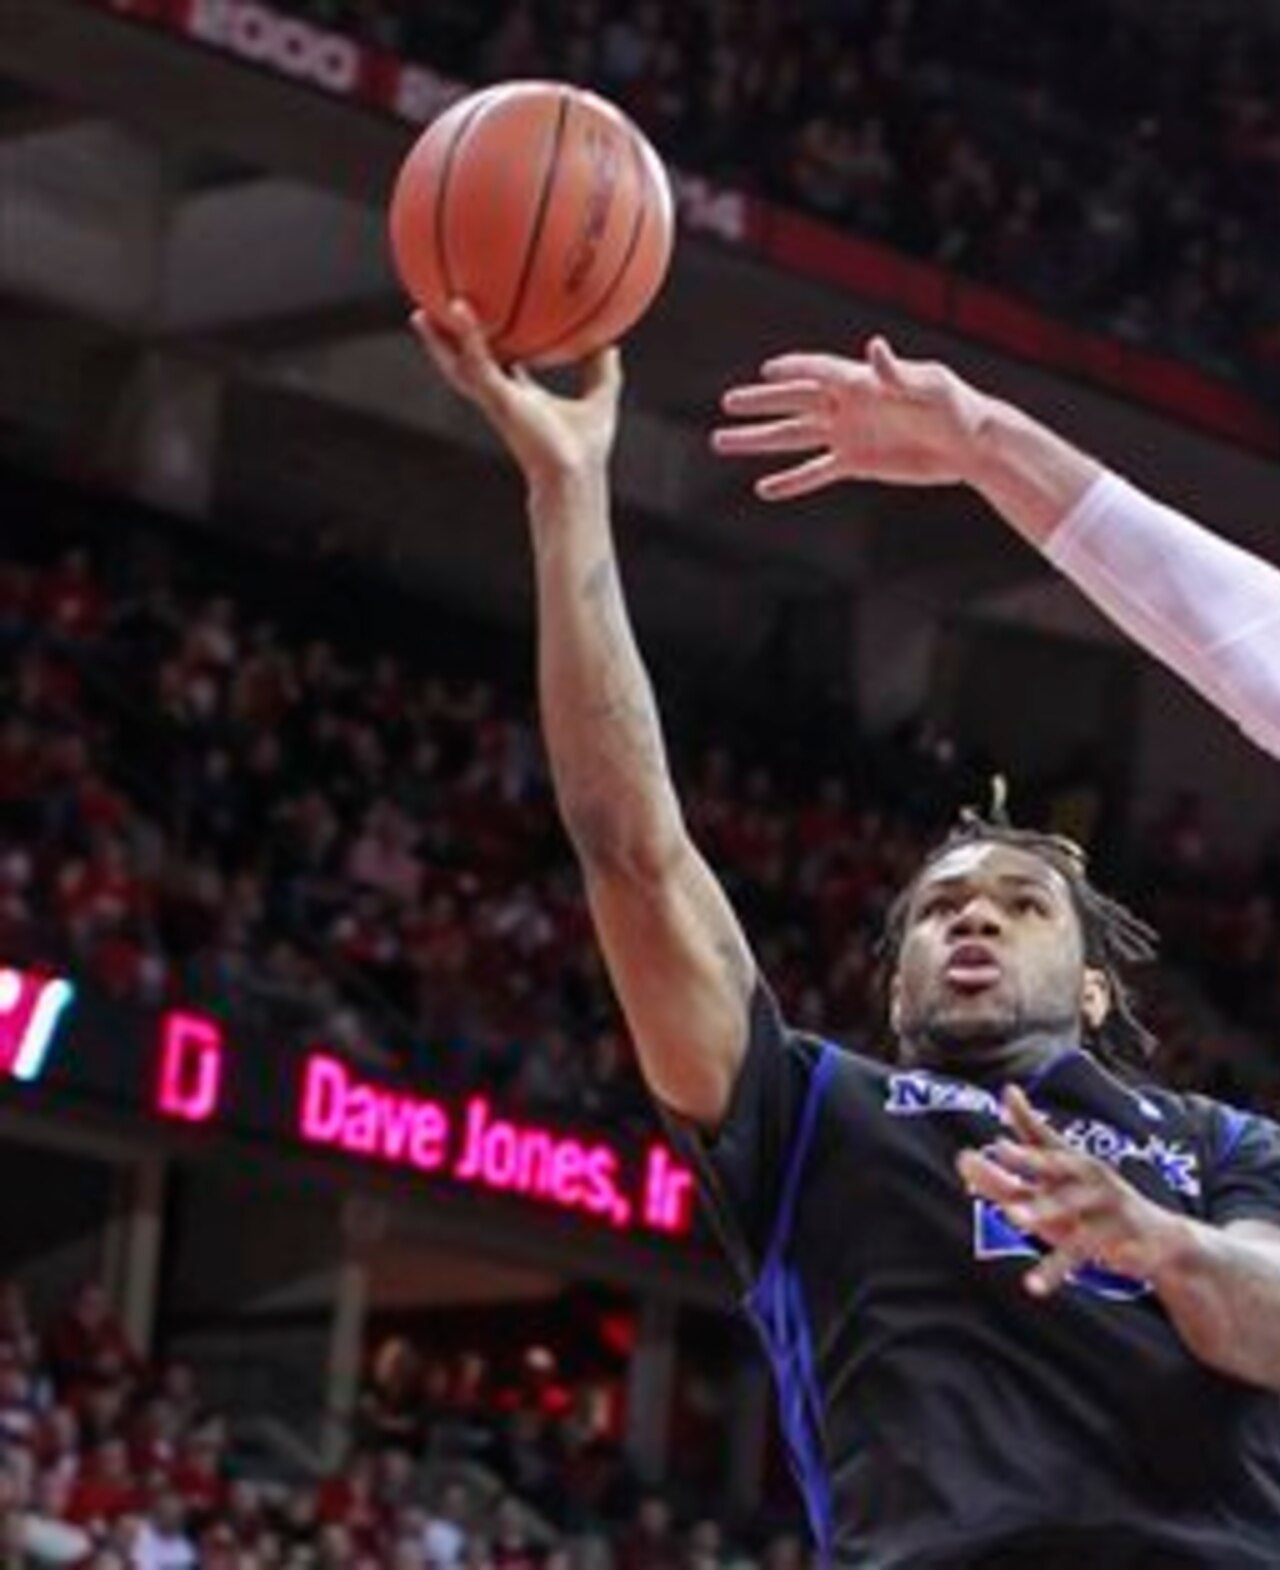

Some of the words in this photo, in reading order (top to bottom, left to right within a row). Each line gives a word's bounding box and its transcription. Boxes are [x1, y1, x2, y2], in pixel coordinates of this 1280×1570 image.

[189, 0, 361, 92] 2000
[303, 1056, 447, 1168] Dave
[456, 1097, 629, 1225] Jones,
